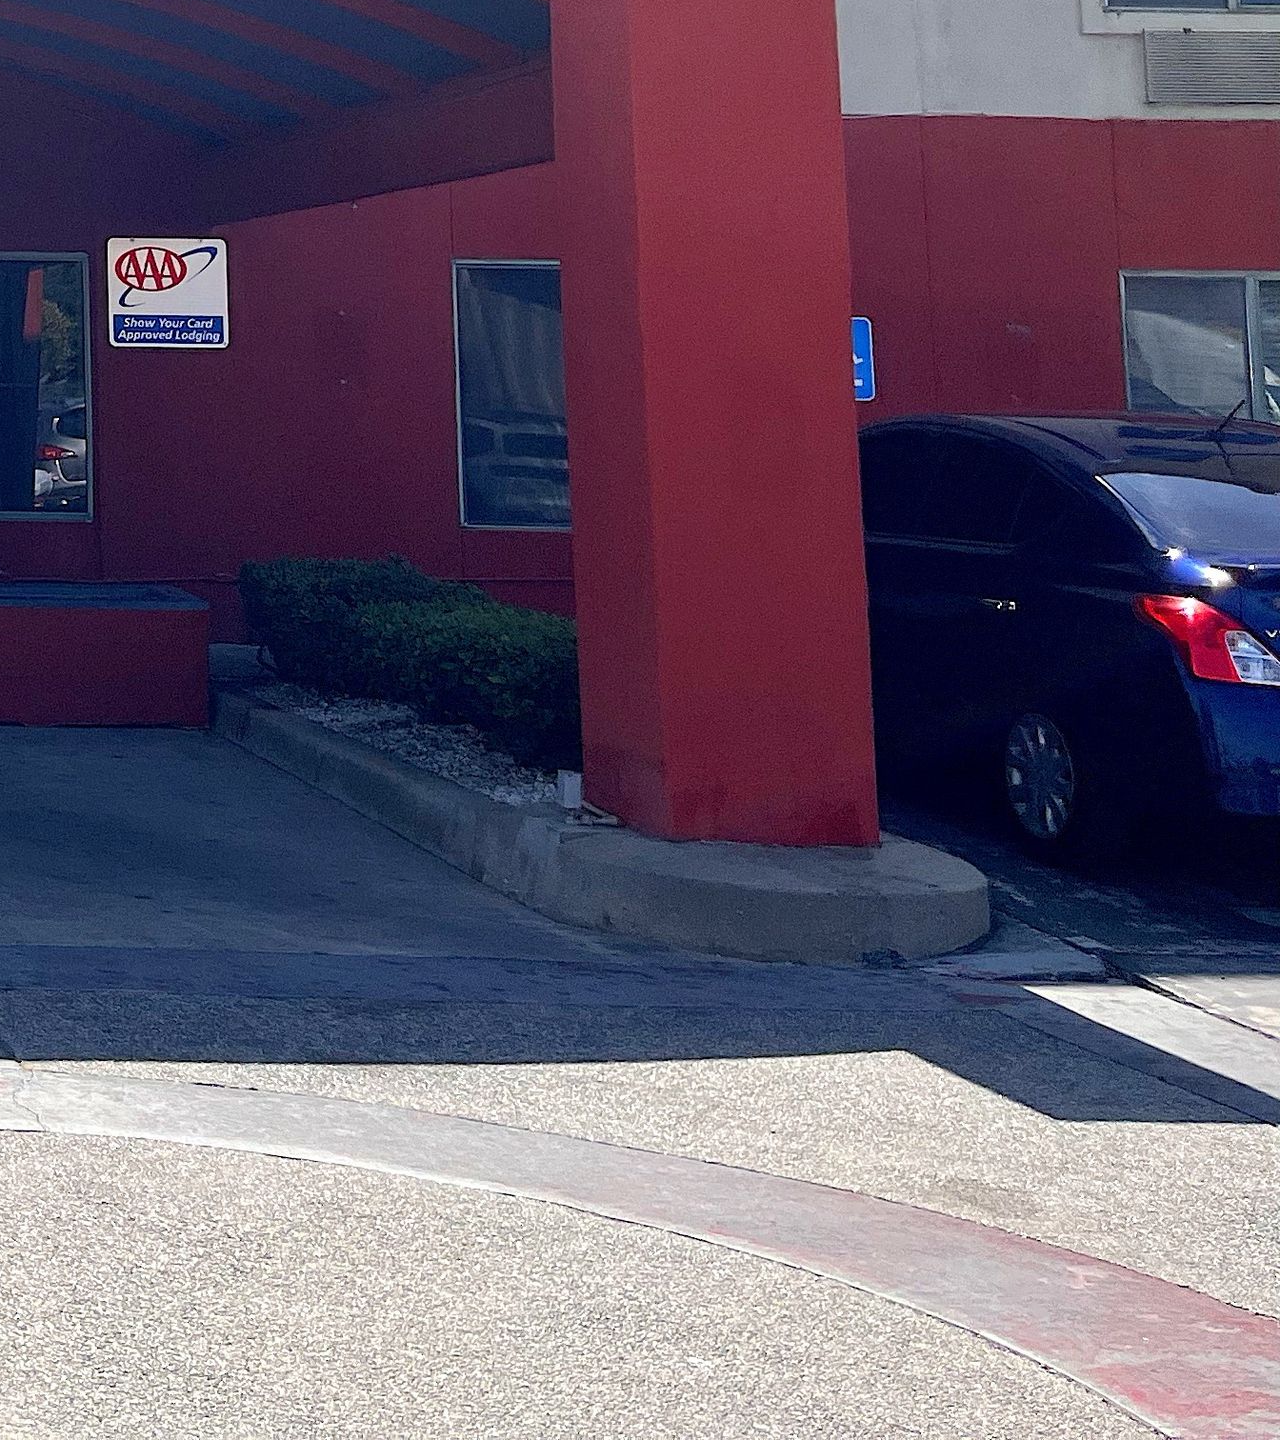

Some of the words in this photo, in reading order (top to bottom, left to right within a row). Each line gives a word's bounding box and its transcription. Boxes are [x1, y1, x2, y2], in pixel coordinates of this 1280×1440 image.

[121, 248, 182, 290] AAA
[123, 317, 156, 328] Show
[159, 318, 184, 329] Your
[187, 318, 213, 329] Card
[117, 329, 173, 342] Approved
[175, 330, 220, 343] Lodging
